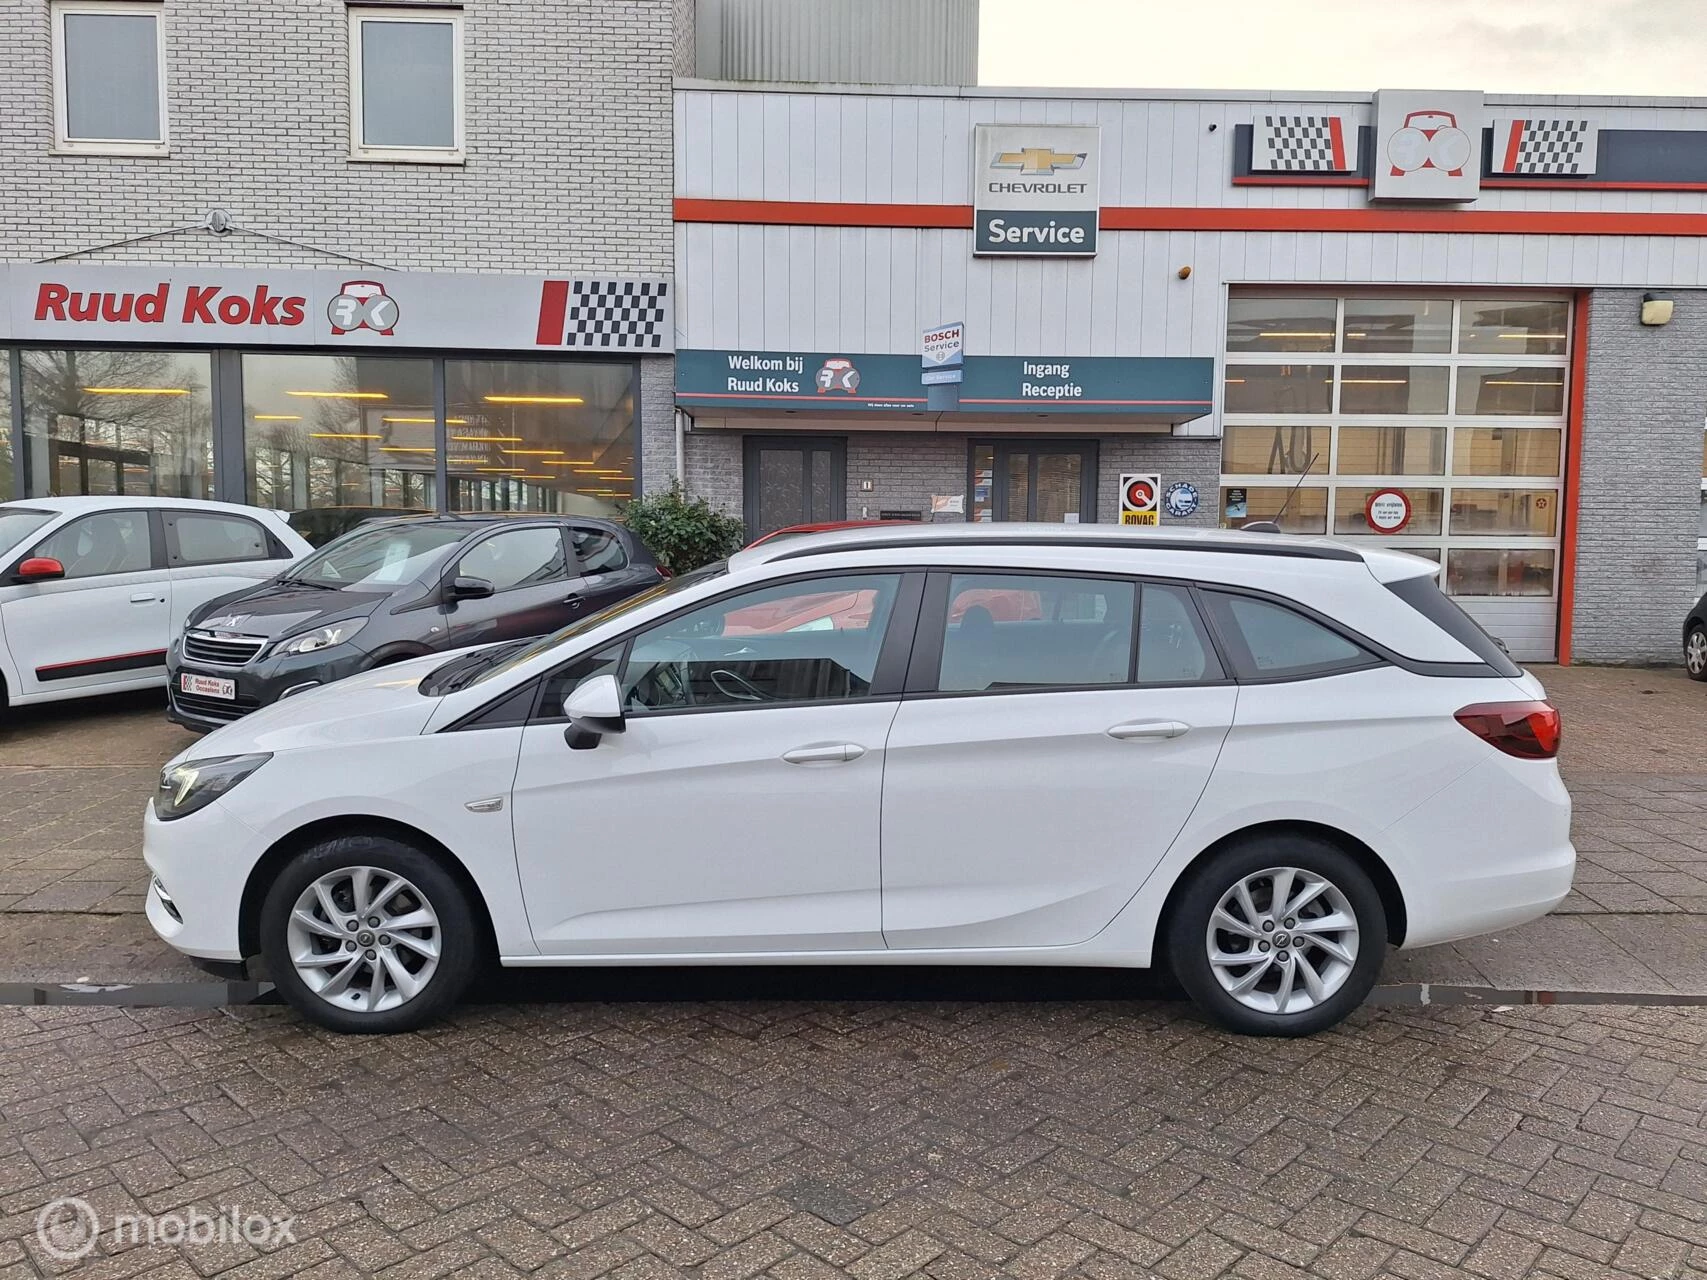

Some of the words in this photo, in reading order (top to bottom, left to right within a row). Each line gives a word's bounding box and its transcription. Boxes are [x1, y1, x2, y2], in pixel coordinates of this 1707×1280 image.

[988, 182, 1088, 194] CHEVROLET
[988, 218, 1085, 243] Service
[34, 283, 170, 323] Ruud
[182, 285, 306, 326] Koks
[924, 328, 960, 344] BOSCH
[924, 340, 960, 353] Service
[728, 355, 783, 371] Welkom
[786, 356, 804, 374] bij
[1023, 361, 1070, 379] Ingang
[727, 377, 763, 392] Ruud
[766, 378, 800, 393] Koks
[1022, 382, 1083, 400] Receptie
[1165, 482, 1198, 498] SCHADE
[1165, 502, 1197, 517] GARANT
